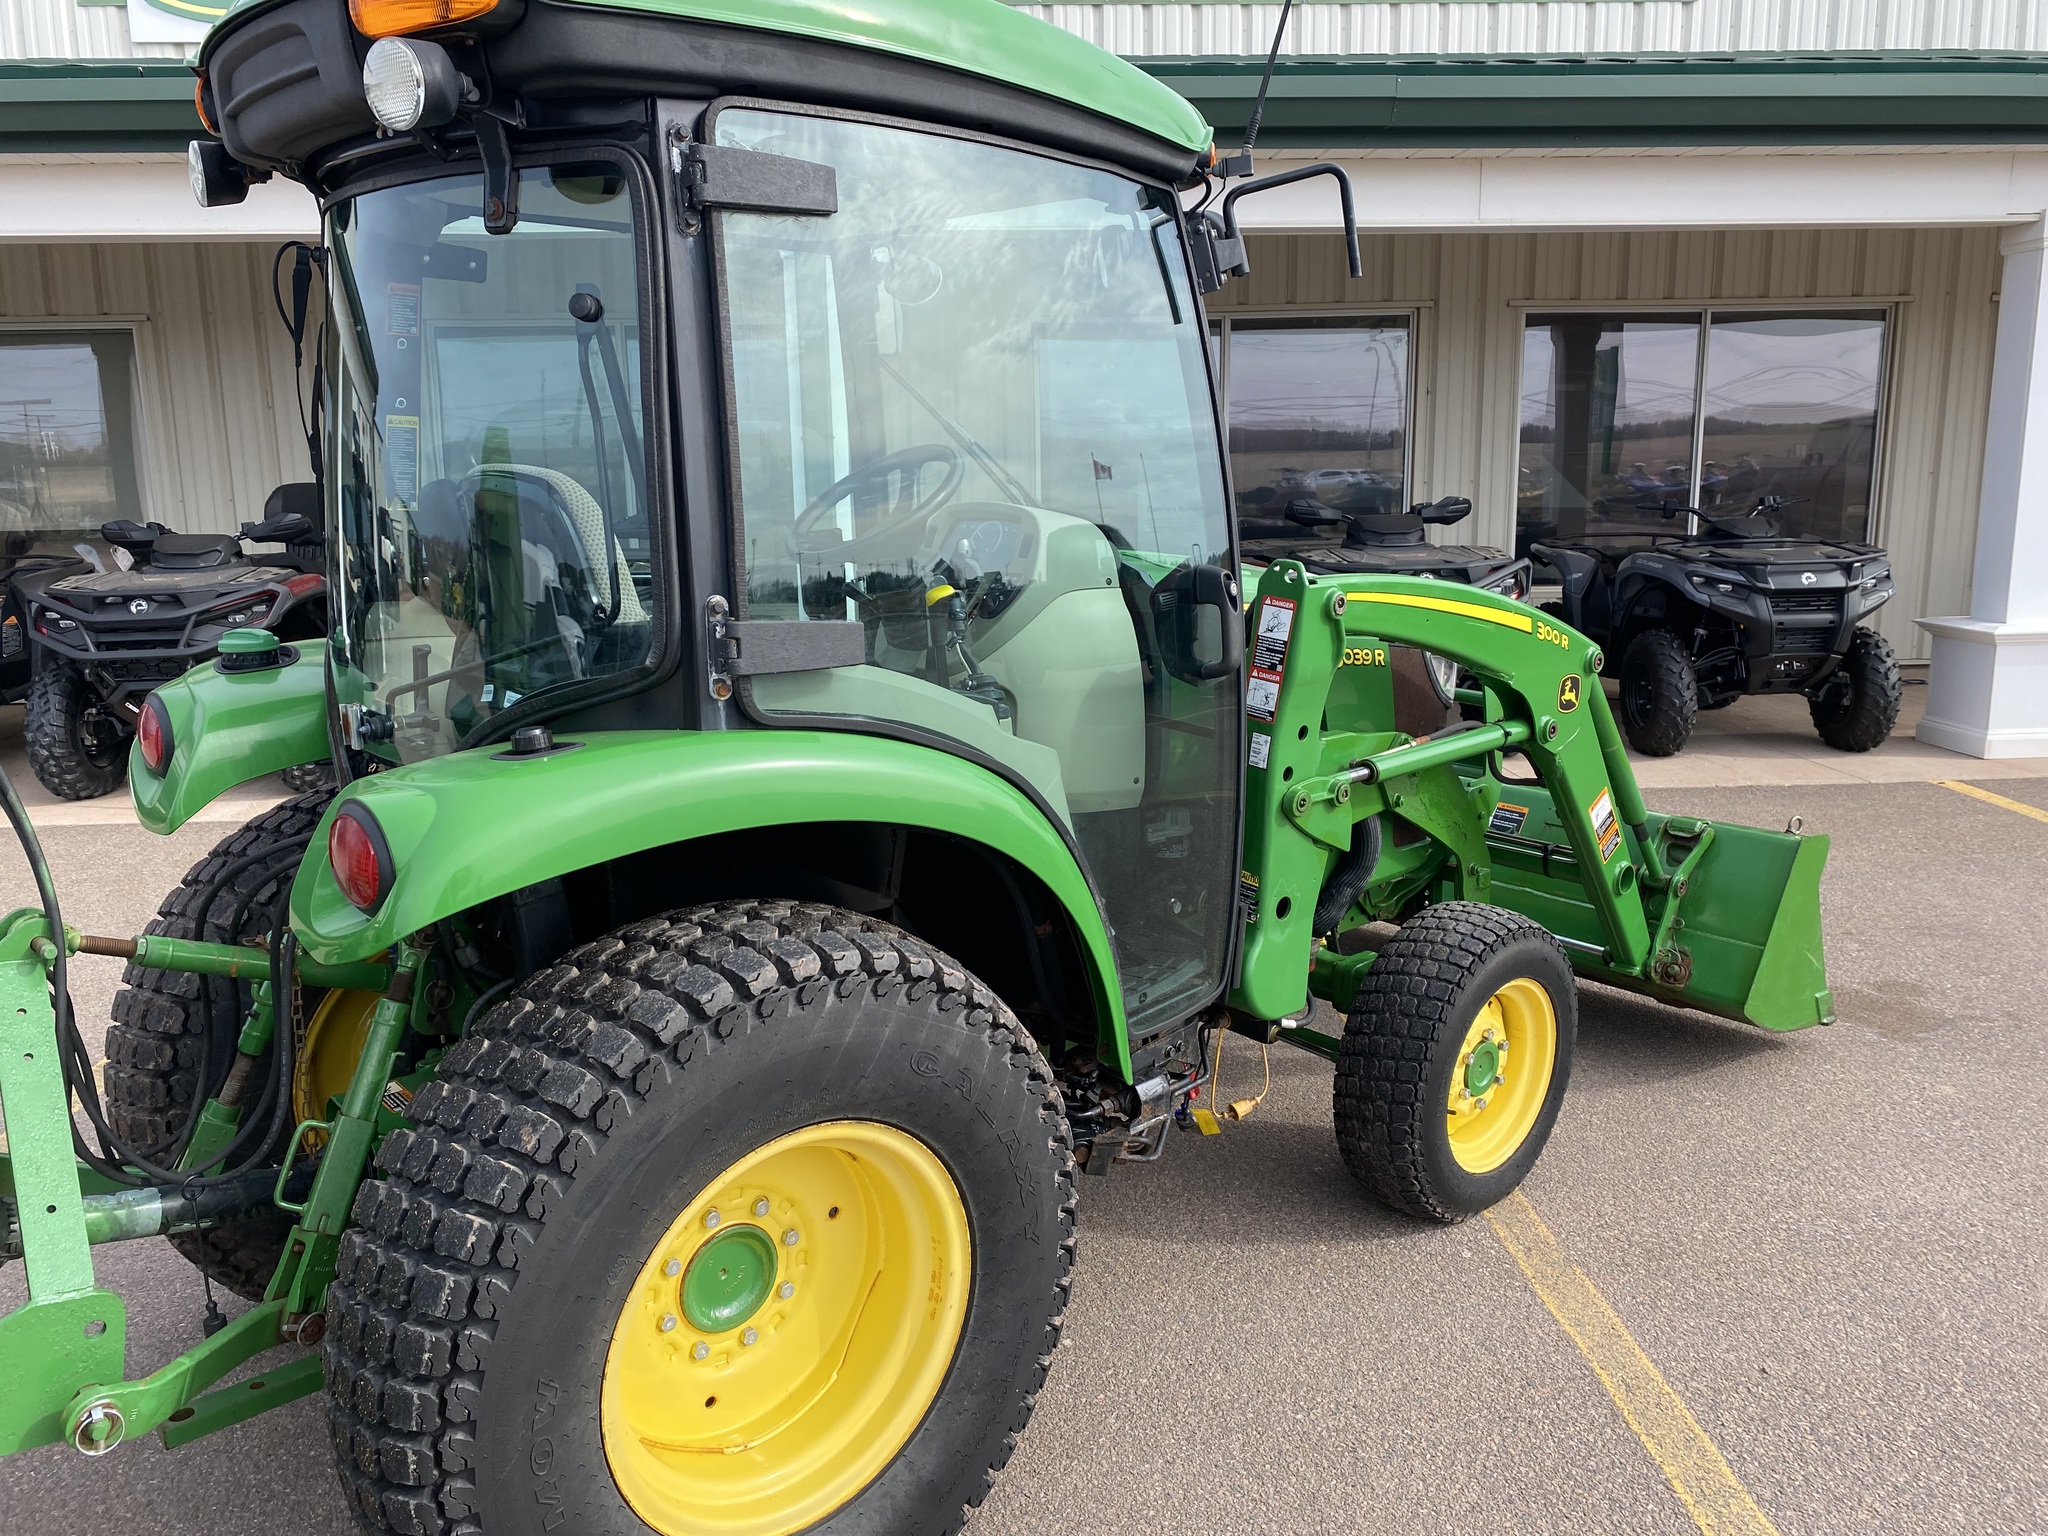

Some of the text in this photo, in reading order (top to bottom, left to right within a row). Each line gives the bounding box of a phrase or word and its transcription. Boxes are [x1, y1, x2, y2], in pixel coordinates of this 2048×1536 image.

[1271, 599, 1294, 609] DANGER
[1536, 620, 1569, 651] 300 R
[1338, 648, 1386, 668] 039 R
[1259, 671, 1280, 681] DANGER
[910, 1050, 1041, 1246] GALAXY
